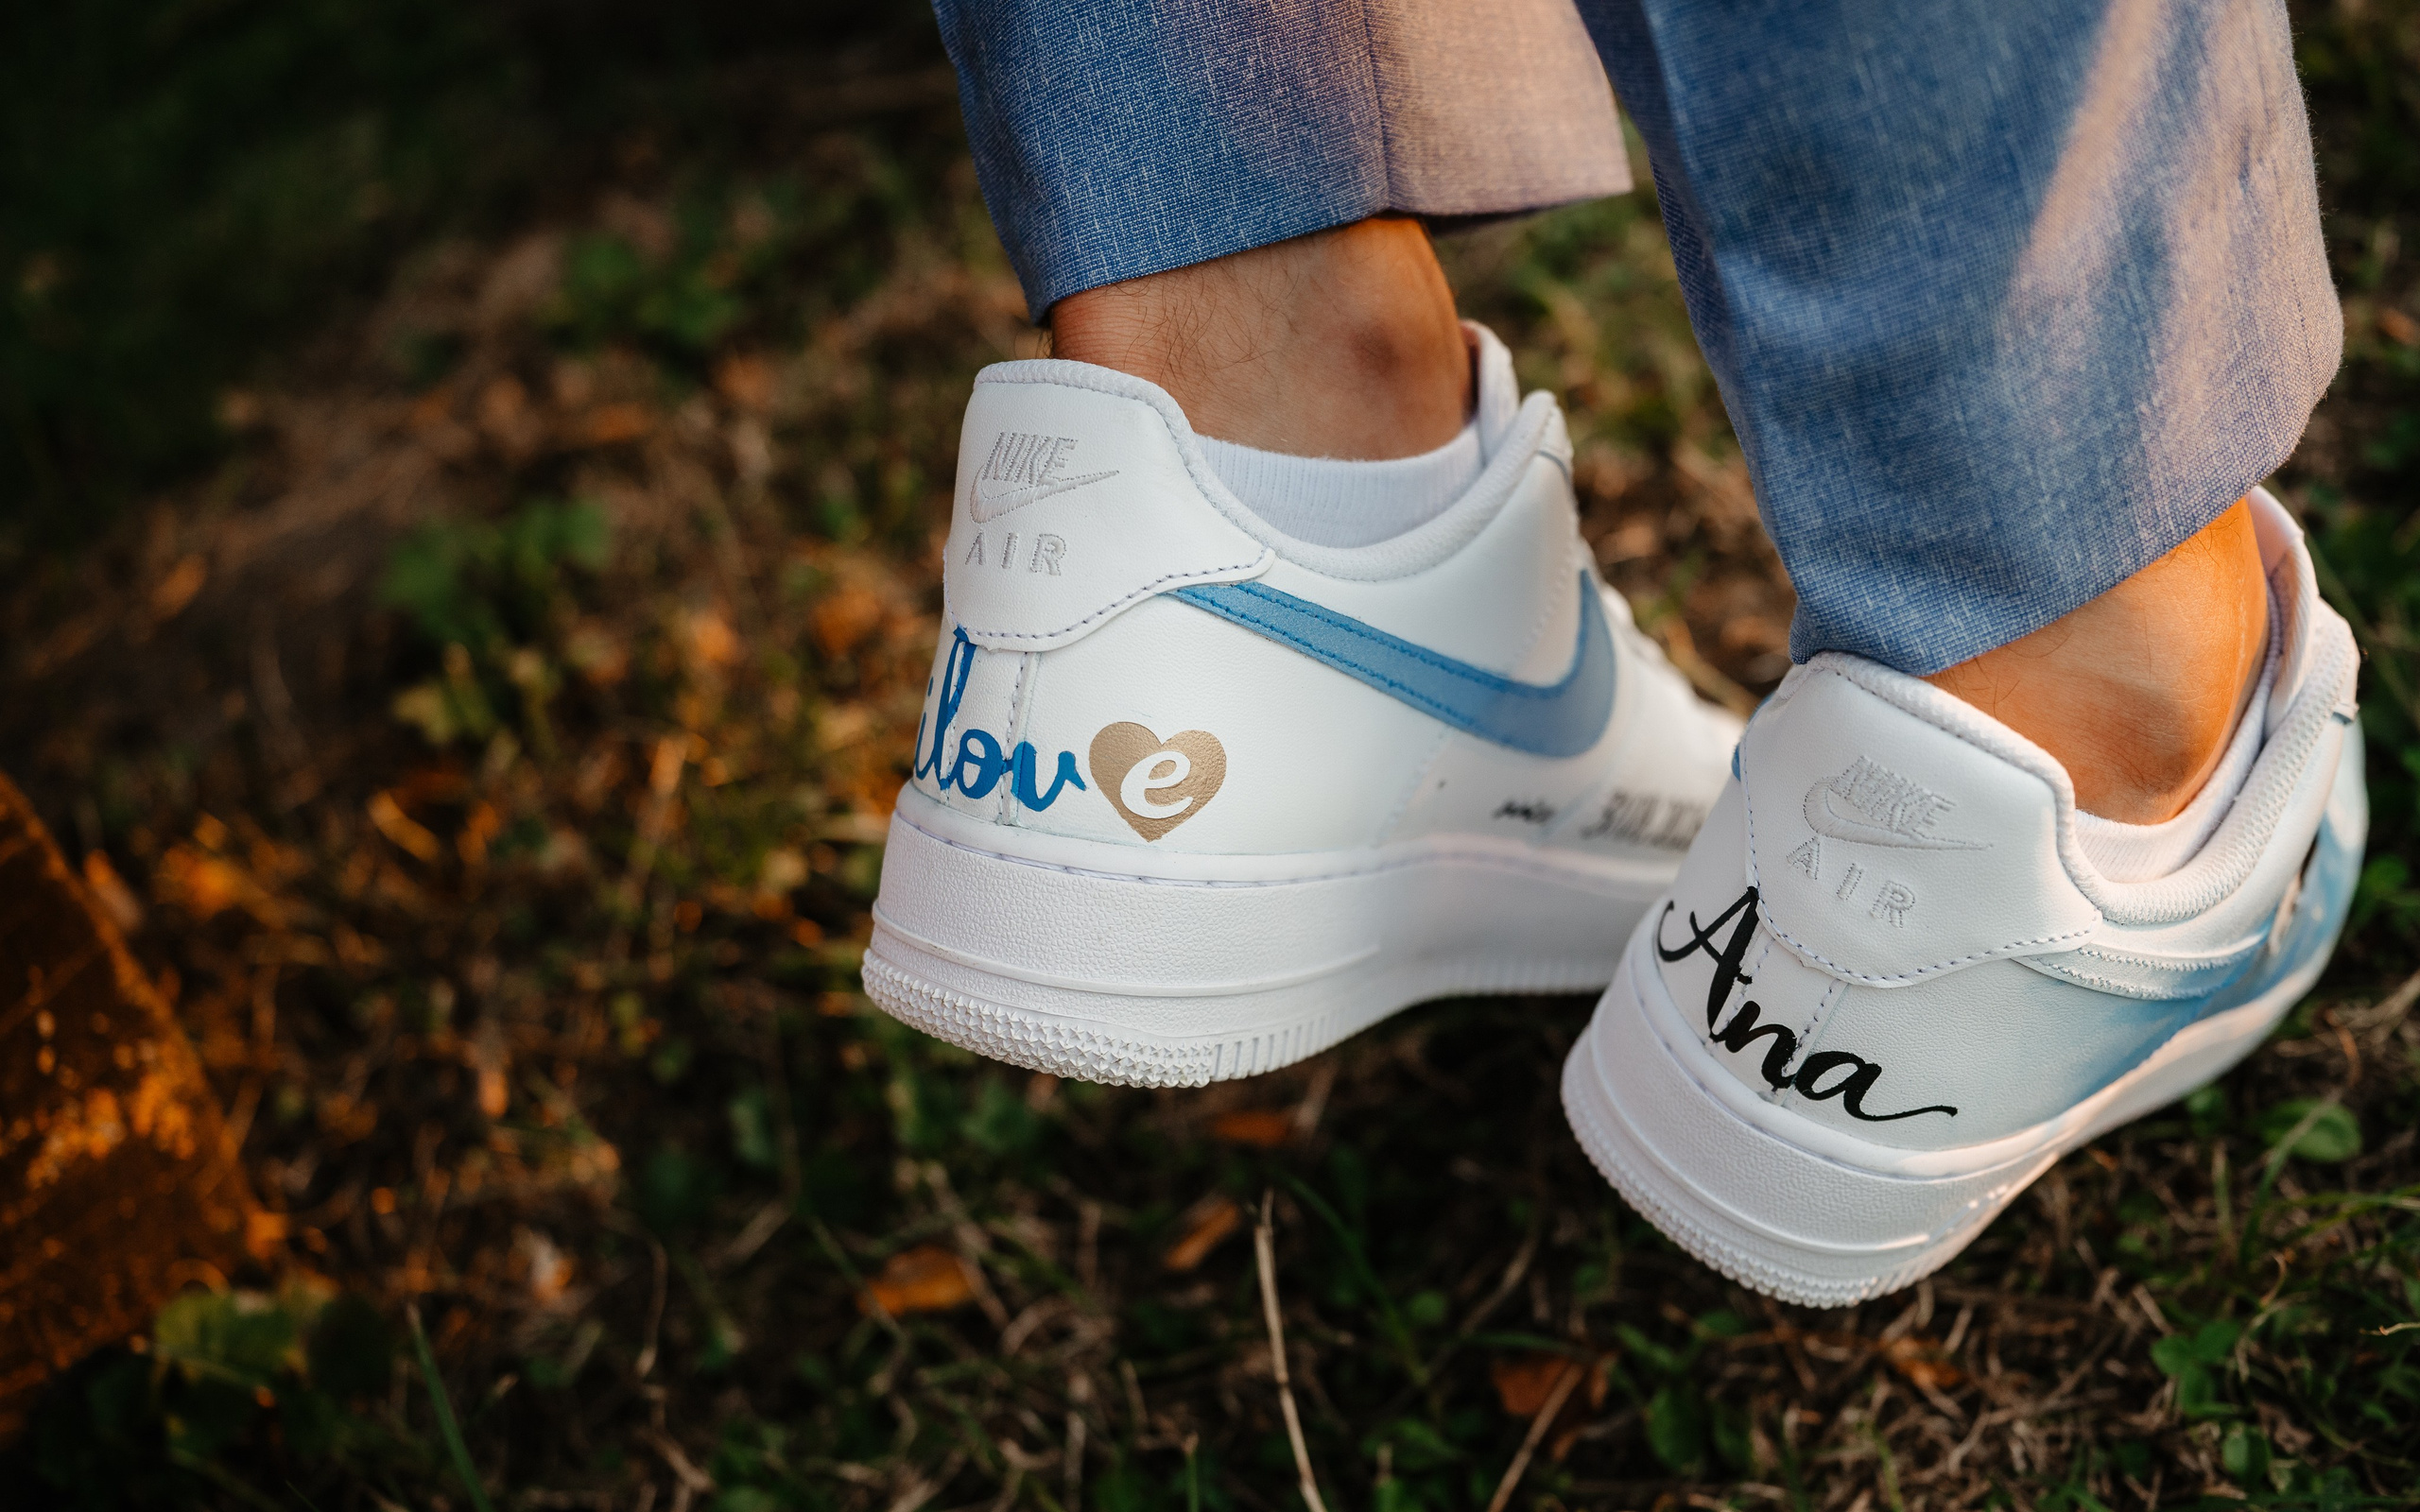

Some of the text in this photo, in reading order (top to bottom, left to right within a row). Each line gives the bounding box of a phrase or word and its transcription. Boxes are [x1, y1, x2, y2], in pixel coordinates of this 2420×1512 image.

[982, 431, 1079, 486] NIKE
[964, 530, 1066, 576] AIR
[1828, 755, 1957, 835] NIKE
[1786, 835, 1917, 928] AIR
[1657, 885, 1958, 1122] Ana
